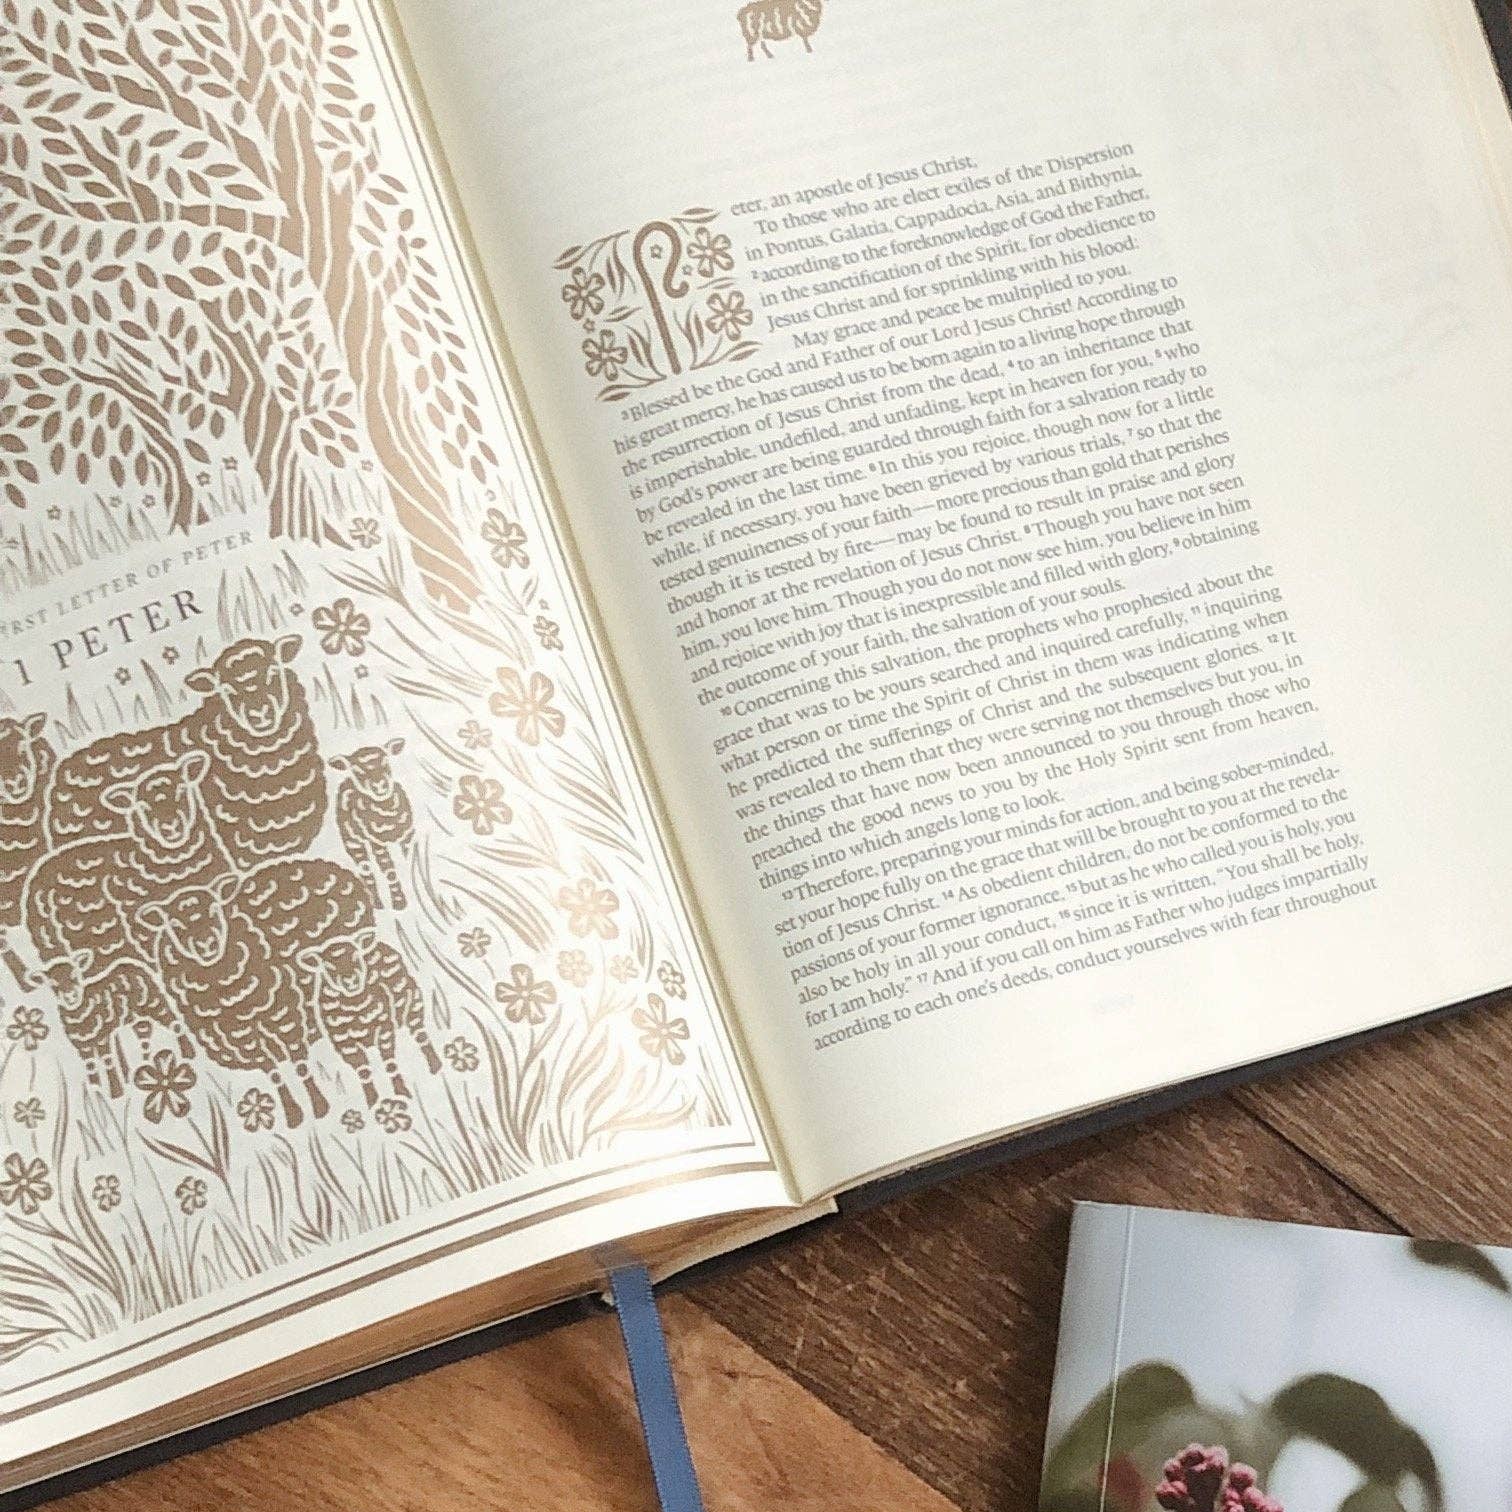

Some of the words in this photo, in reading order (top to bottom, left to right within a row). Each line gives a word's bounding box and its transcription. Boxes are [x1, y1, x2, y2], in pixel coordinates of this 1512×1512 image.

[744, 246, 764, 261] in
[1035, 178, 1067, 200] and
[755, 218, 778, 234] To
[781, 210, 827, 229] those
[830, 201, 869, 218] who
[873, 196, 899, 211] are
[902, 186, 940, 205] elect
[944, 175, 991, 196] exiles
[994, 167, 1011, 185] of
[1015, 163, 1043, 180] the
[1045, 143, 1133, 174] Dispersion
[770, 193, 791, 208] an
[794, 178, 853, 204] apostle
[856, 172, 873, 190] of
[876, 167, 919, 190] Jesus
[758, 291, 779, 307] in
[780, 285, 809, 302] the
[812, 262, 923, 295] sanctification
[924, 253, 942, 271] of
[945, 250, 973, 267] the
[1028, 233, 1051, 249] for
[1055, 214, 1136, 243] obedience
[1137, 209, 1155, 223] to
[766, 309, 811, 333] Jesus
[812, 297, 866, 319] Christ
[868, 286, 901, 308] and
[902, 284, 926, 300] for
[930, 266, 1018, 295] sprinkling
[1018, 254, 1058, 274] with
[1058, 247, 1085, 265] his
[791, 330, 828, 348] May
[832, 319, 877, 342] grace
[880, 308, 913, 329] and
[914, 302, 960, 325] peace
[961, 296, 983, 311] be
[986, 273, 1073, 306] multiplied
[1075, 272, 1094, 286] to
[612, 434, 638, 455] his
[638, 418, 680, 447] great
[733, 395, 758, 412] he
[756, 388, 788, 405] has
[789, 371, 845, 398] caused
[846, 370, 868, 384] us
[868, 366, 887, 379] to
[886, 360, 908, 375] be
[908, 352, 950, 370] born
[951, 341, 997, 362] again
[998, 338, 1015, 351] to
[1017, 335, 1028, 347] a
[1027, 324, 1077, 345] living
[1075, 314, 1117, 333] hope
[1119, 294, 1185, 324] through
[56, 573, 139, 616] LETTER
[146, 558, 173, 579] OF
[182, 531, 254, 565] PETER
[719, 623, 753, 648] you
[752, 611, 790, 633] love
[835, 579, 903, 608] Though
[905, 574, 938, 594] you
[940, 566, 962, 582] do
[965, 560, 995, 577] not
[997, 551, 1032, 570] now
[1036, 545, 1062, 561] see
[1104, 527, 1136, 548] you
[1136, 512, 1195, 536] believe
[1196, 506, 1216, 521] in
[1215, 498, 1251, 516] him
[50, 590, 203, 671] PETER
[696, 686, 724, 706] the
[725, 660, 798, 694] outcome
[799, 649, 817, 669] of
[820, 642, 859, 667] your
[910, 622, 939, 639] the
[941, 604, 1016, 632] salvation
[1018, 595, 1035, 613] of
[1038, 589, 1076, 612] your
[719, 749, 760, 774] what
[763, 729, 820, 761] person
[824, 722, 842, 737] or
[847, 710, 887, 730] time
[891, 701, 920, 718] the
[923, 687, 971, 711] Spirit
[975, 679, 992, 697] of
[997, 670, 1048, 692] Christ
[1052, 664, 1070, 679] in
[1074, 654, 1118, 674] them
[1121, 644, 1153, 661] was
[1156, 622, 1240, 653] indicating
[1242, 610, 1288, 630] when
[750, 826, 823, 870] preached
[827, 820, 856, 838] the
[860, 801, 904, 831] good
[910, 792, 953, 814] news
[958, 787, 976, 801] to
[980, 778, 1013, 799] you
[1016, 771, 1038, 787] by
[1044, 763, 1072, 779] the
[1075, 750, 1115, 771] Holy
[1122, 737, 1168, 760] Spirit
[1173, 728, 1208, 747] sent
[1212, 717, 1253, 736] from
[758, 859, 811, 890] things
[810, 848, 846, 869] into
[848, 828, 901, 856] which
[904, 814, 958, 841] angels
[959, 806, 1001, 825] long
[1002, 801, 1020, 814] to
[814, 1013, 891, 1051] according
[892, 1007, 911, 1022] to
[913, 991, 953, 1014] each
[1055, 947, 1121, 975] conduct
[1123, 924, 1207, 960] yourselves
[1209, 911, 1248, 932] with
[1250, 904, 1280, 922] fear
[1284, 877, 1377, 913] throughout
